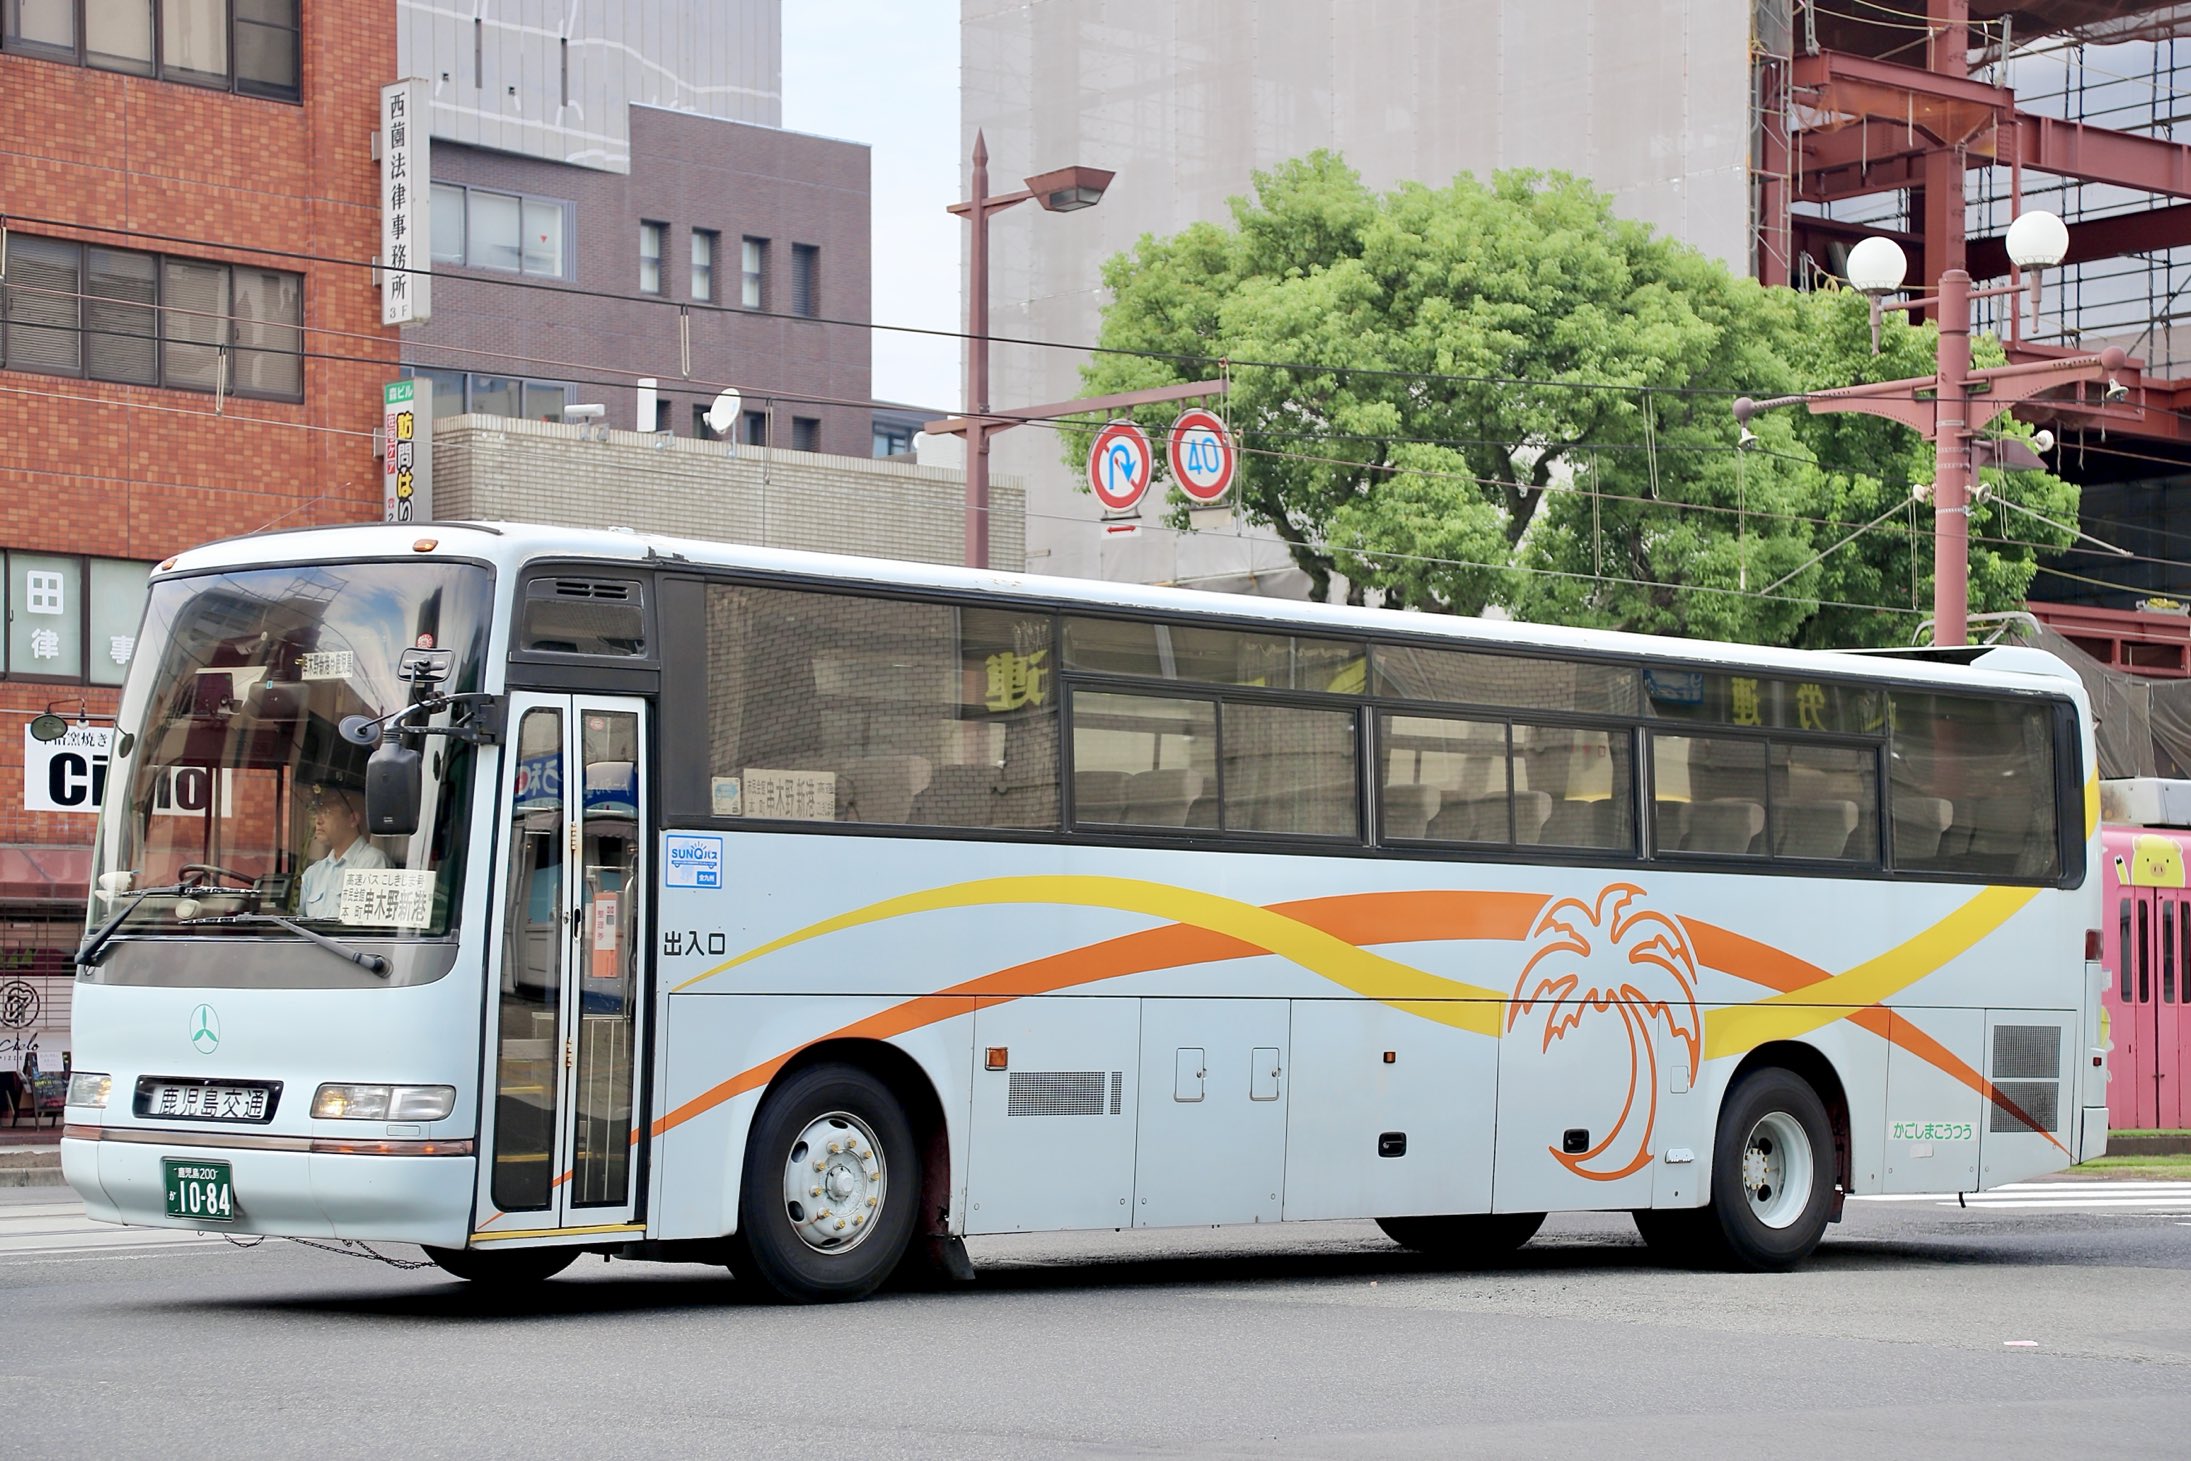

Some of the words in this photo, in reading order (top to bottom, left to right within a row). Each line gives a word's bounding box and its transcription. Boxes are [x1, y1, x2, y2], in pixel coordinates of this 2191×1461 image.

[1188, 436, 1220, 475] 40
[363, 887, 428, 922] 串木野新港
[663, 930, 726, 957] 出入口
[160, 1086, 265, 1119] 鹿児島交通
[1892, 1121, 1973, 1140] かごしまこうつう
[180, 1180, 231, 1216] 10-84
